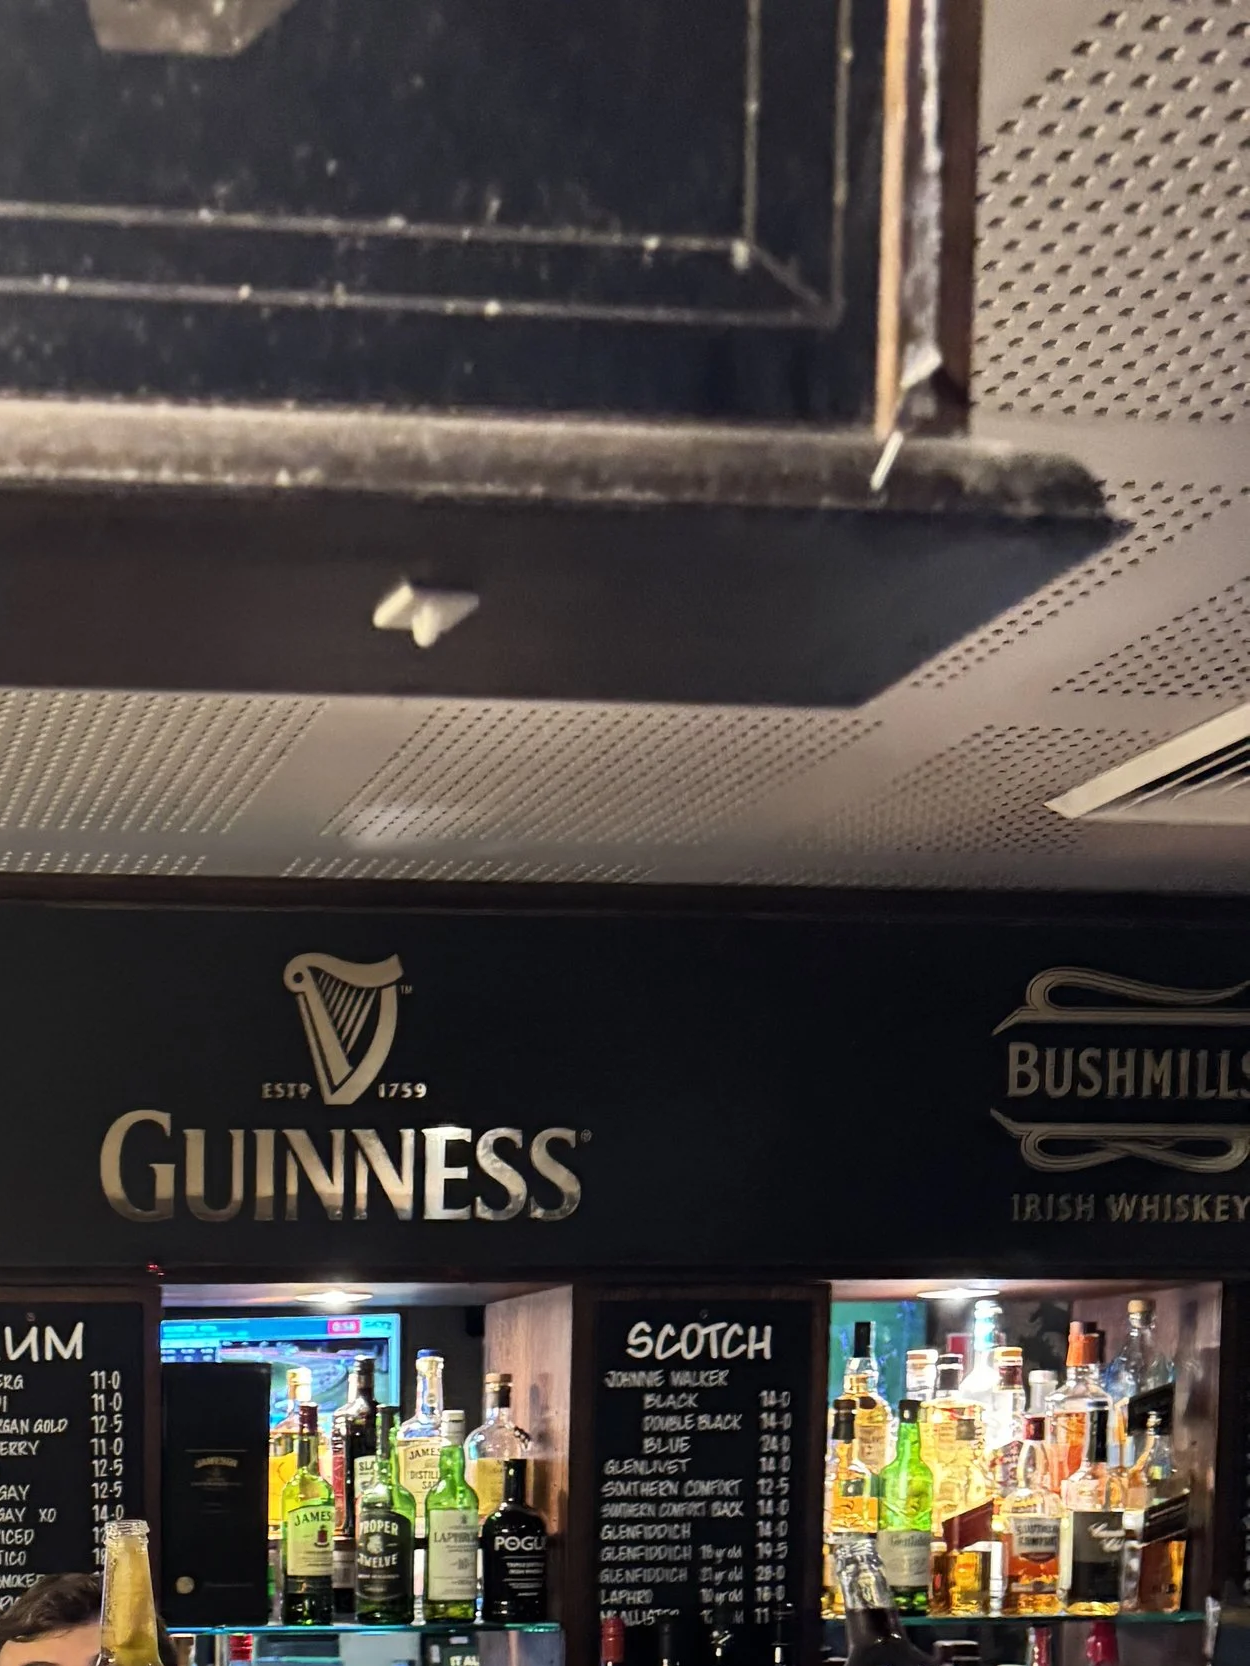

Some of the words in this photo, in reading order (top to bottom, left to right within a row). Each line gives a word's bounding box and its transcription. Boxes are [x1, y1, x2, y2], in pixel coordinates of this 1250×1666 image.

[378, 1082, 427, 1099] 1759
[100, 1109, 583, 1222] GUINNESS
[1011, 1193, 1095, 1222] IRISH
[1106, 1193, 1250, 1223] WHISKEY
[625, 1322, 772, 1360] SCOTCH
[670, 1369, 729, 1388] WALKER
[644, 1393, 699, 1410] BLACK
[34, 1418, 68, 1434] GOLD
[642, 1414, 694, 1432] DOUBLE
[697, 1414, 742, 1431] BLACK
[643, 1436, 691, 1453] BLUE
[604, 1458, 692, 1475] GLENLIVET
[601, 1480, 678, 1498] SOUTHERN
[683, 1479, 742, 1497] COMFORT
[39, 1508, 56, 1522] XO
[294, 1510, 331, 1527] JAMES
[600, 1523, 691, 1540] GLENFIDDICH
[600, 1545, 692, 1562] GLENFIDDICH
[600, 1567, 688, 1583] GLENFIDDICH
